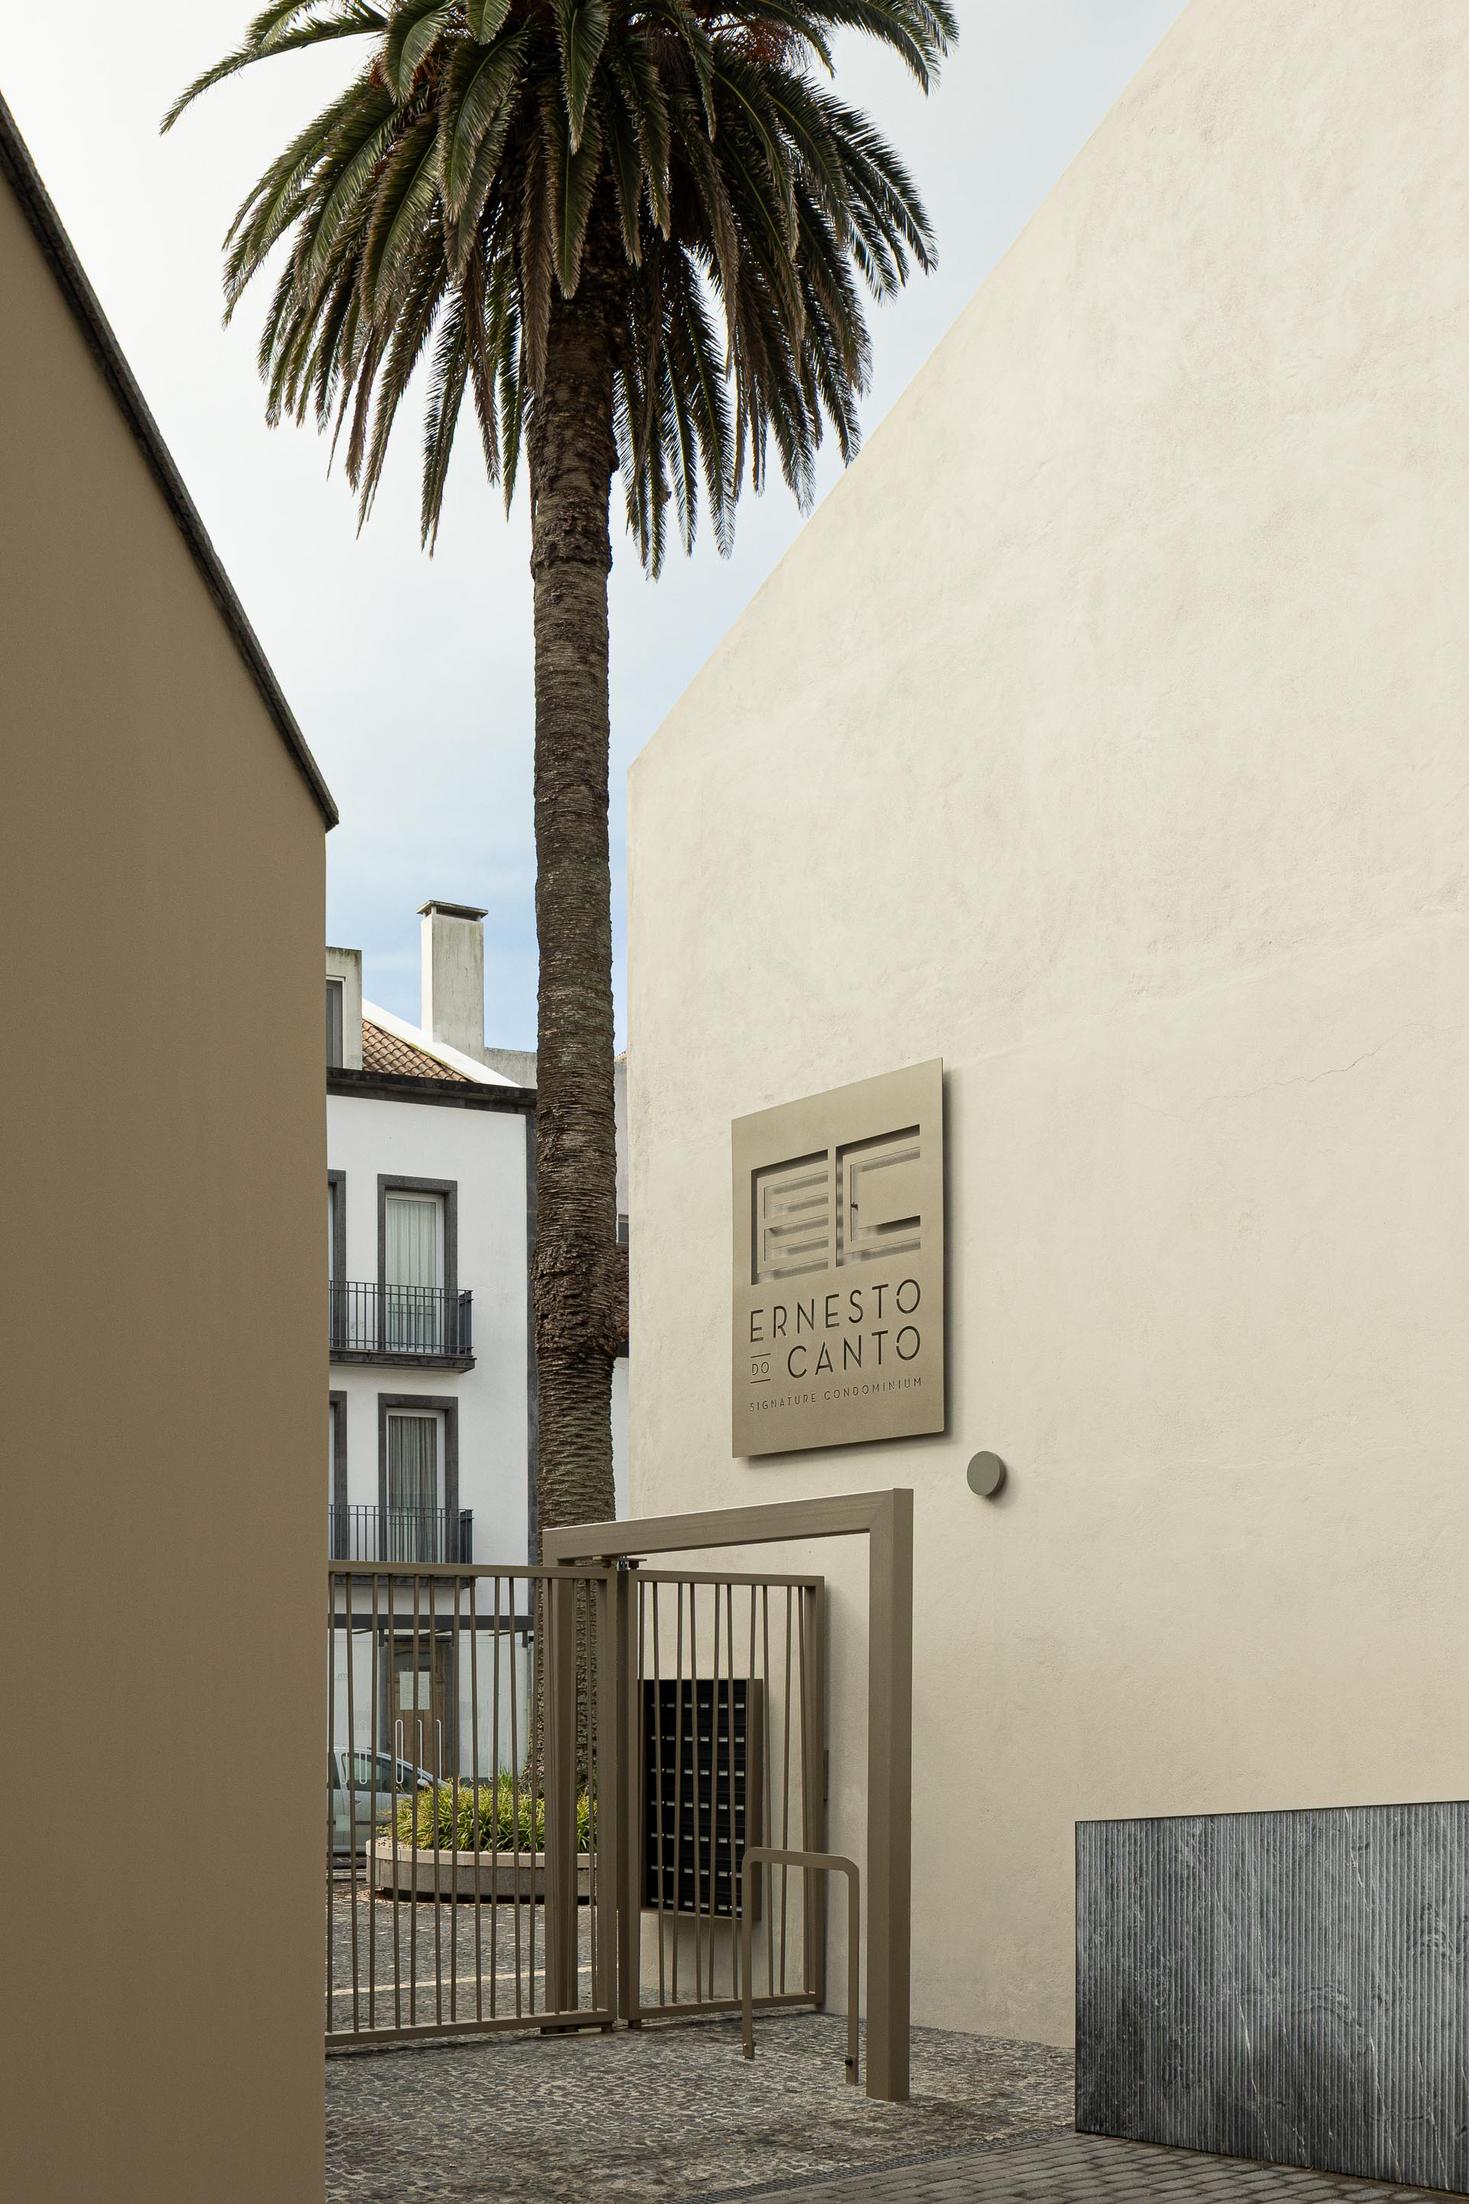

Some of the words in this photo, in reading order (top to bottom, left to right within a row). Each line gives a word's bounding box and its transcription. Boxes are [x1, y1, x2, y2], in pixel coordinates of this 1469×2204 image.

[750, 1279, 921, 1342] ERNESTO
[751, 1362, 769, 1376] DO
[788, 1326, 921, 1378] CANTO
[750, 1393, 816, 1412] SIGNATURE
[824, 1377, 922, 1400] CONDOMINIUM
